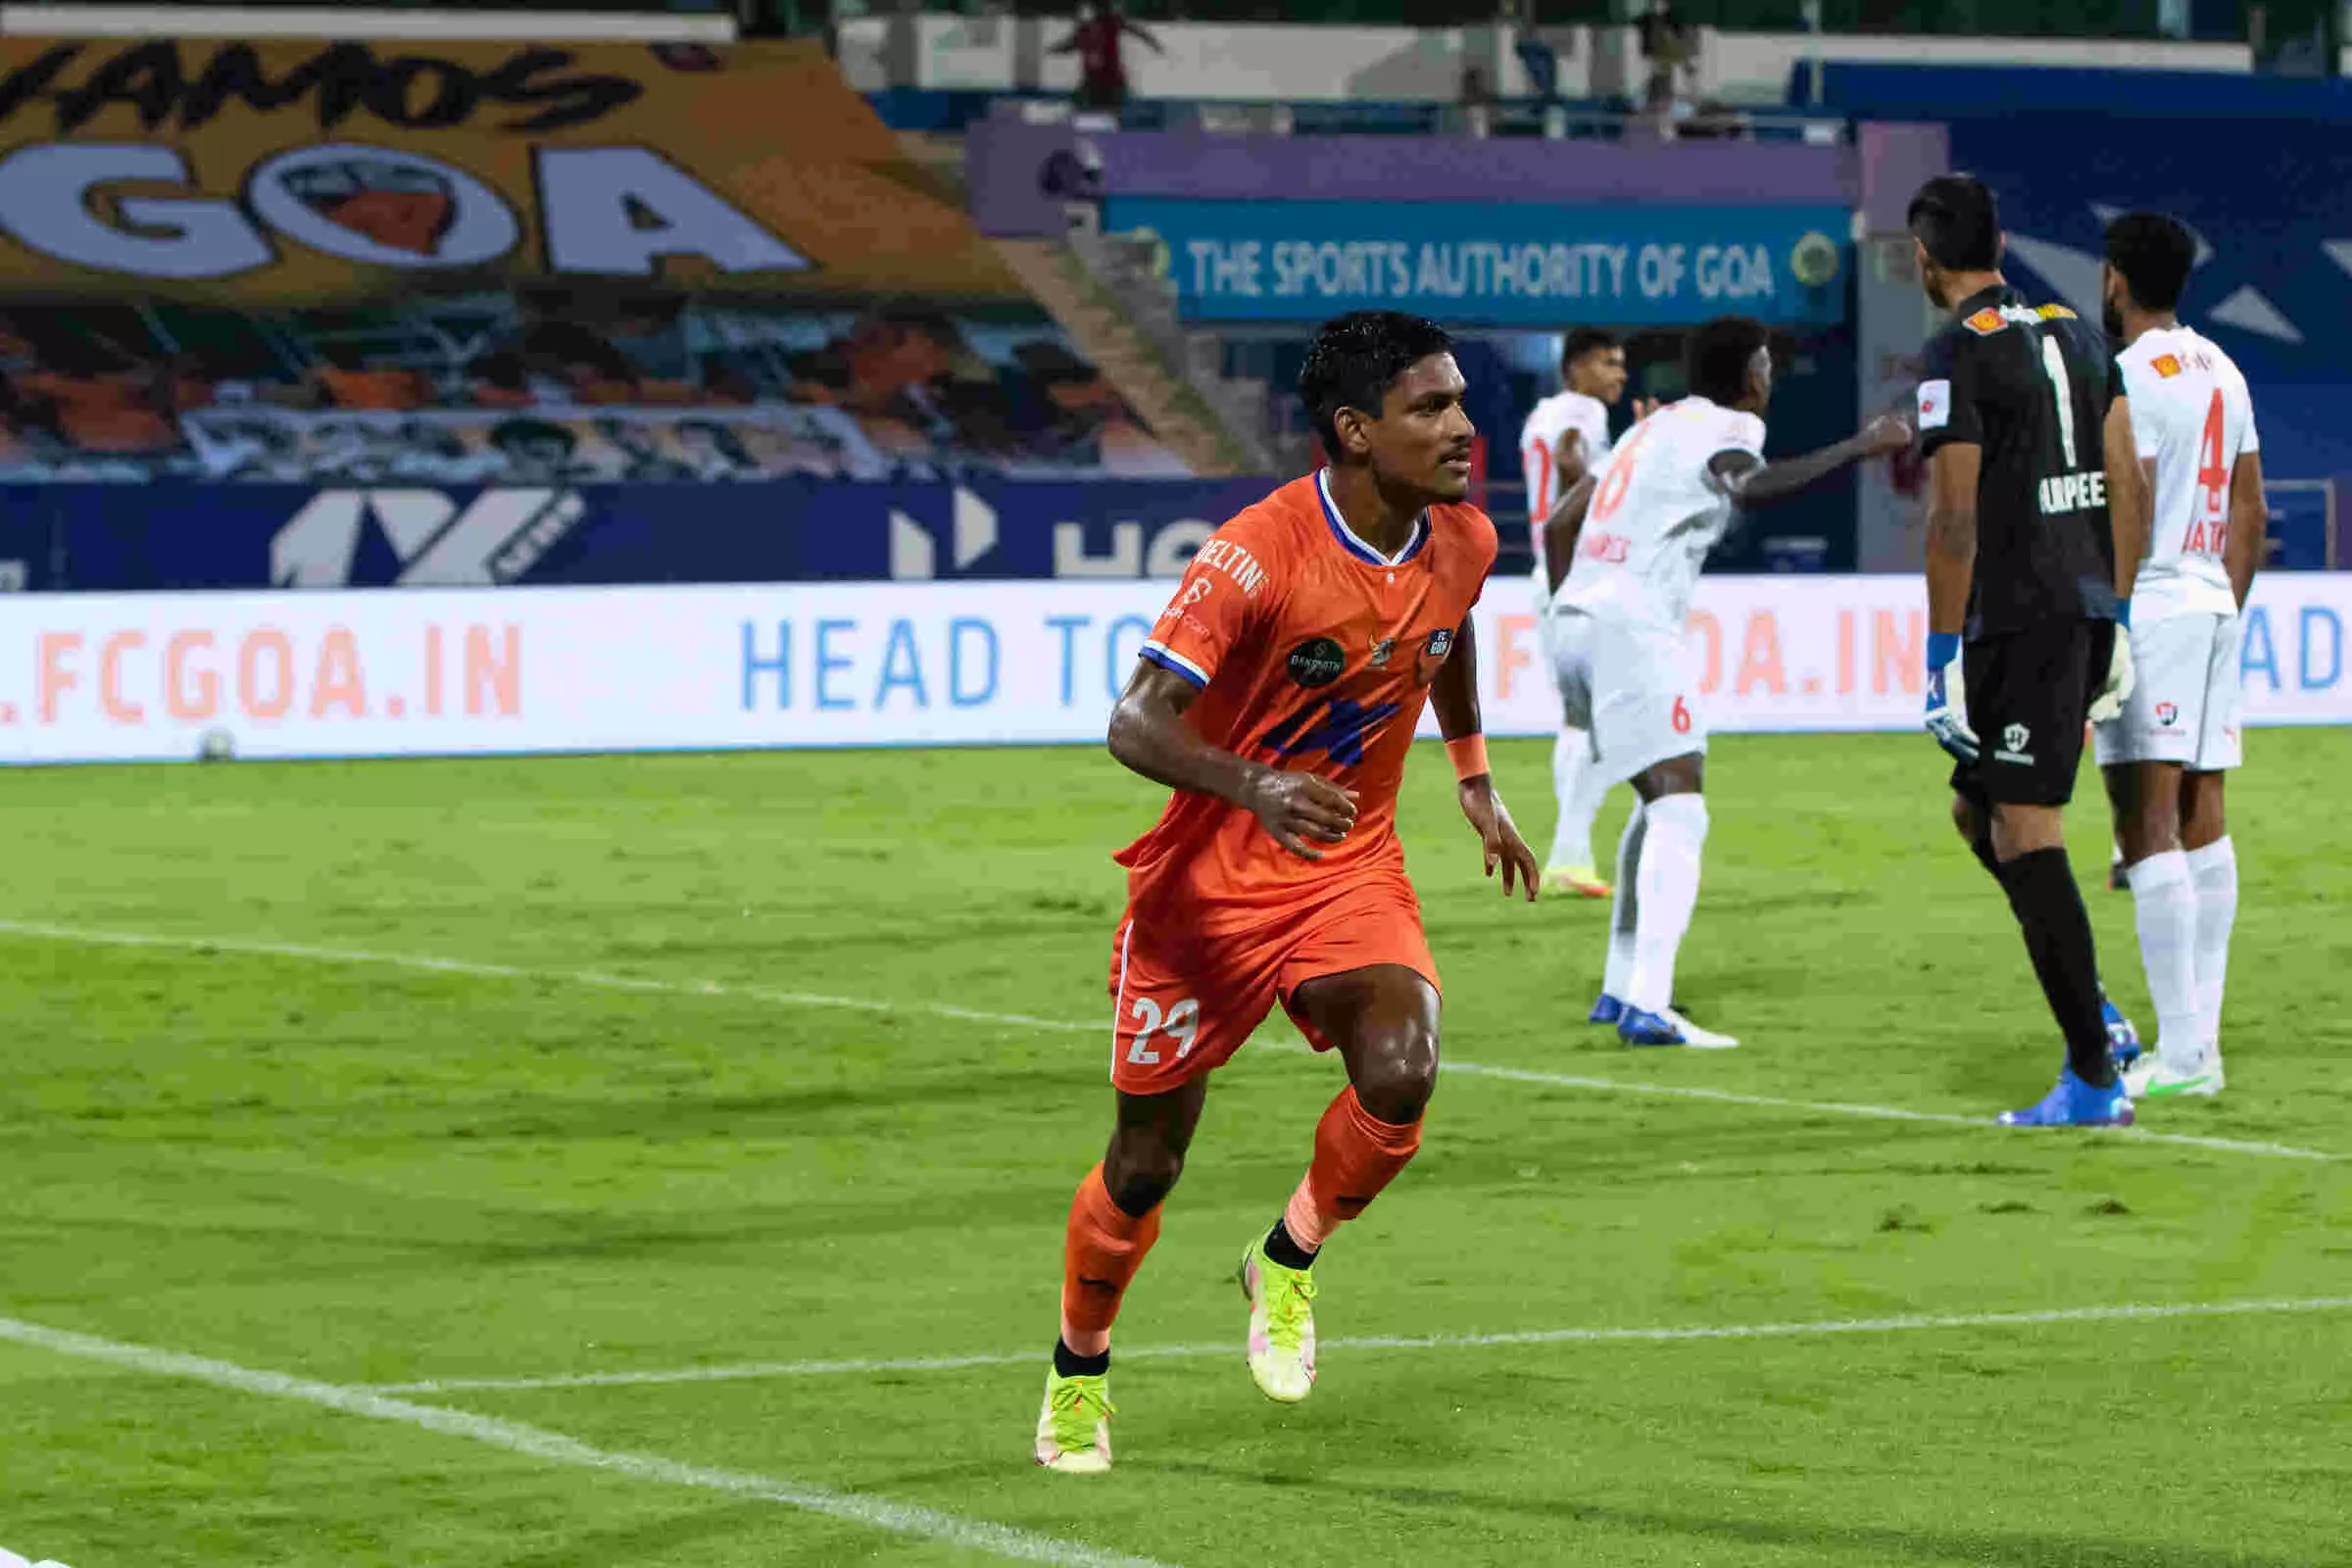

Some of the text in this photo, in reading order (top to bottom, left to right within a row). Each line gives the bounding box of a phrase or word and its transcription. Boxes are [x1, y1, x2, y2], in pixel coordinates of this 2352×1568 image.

[0, 142, 821, 279] GOA
[1187, 240, 1772, 296] THE SPORTS AUTHORITY OF GOA
[2041, 334, 2077, 467] 1
[2198, 387, 2228, 513] 4
[739, 614, 1153, 710] HEAD TO
[2239, 605, 2343, 689] AD
[1671, 697, 1690, 734] 6
[1127, 998, 1199, 1063] 29
